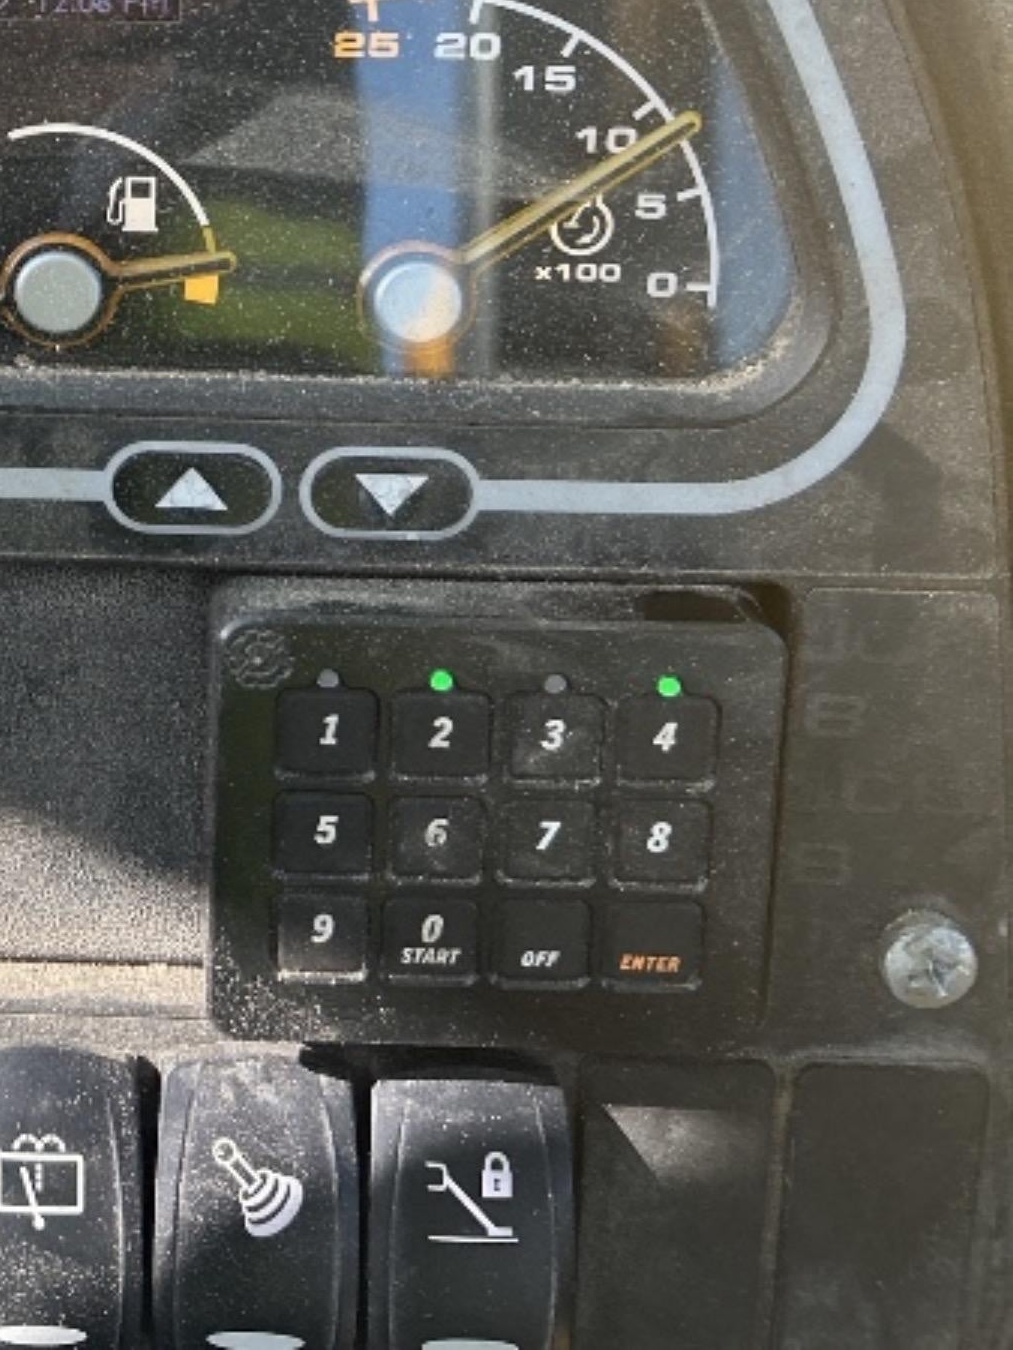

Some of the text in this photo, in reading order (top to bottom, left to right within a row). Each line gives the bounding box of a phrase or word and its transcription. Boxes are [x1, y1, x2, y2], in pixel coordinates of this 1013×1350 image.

[333, 32, 399, 58] 25
[434, 32, 501, 59] 20
[513, 66, 576, 92] 15
[576, 127, 637, 153] 10
[634, 194, 667, 219] 5
[535, 263, 622, 283] x100
[646, 272, 678, 298] 0
[319, 714, 339, 745] 1
[428, 717, 453, 748] 2
[541, 719, 566, 751] 3
[652, 722, 678, 751] 4
[314, 815, 339, 844] 5
[424, 818, 449, 847] 6
[536, 821, 561, 850] 7
[646, 822, 672, 853] 8
[311, 914, 335, 943] 9
[421, 914, 444, 943] 0
[400, 947, 462, 966] START
[520, 950, 560, 967] OFF
[620, 954, 680, 973] ENTER
